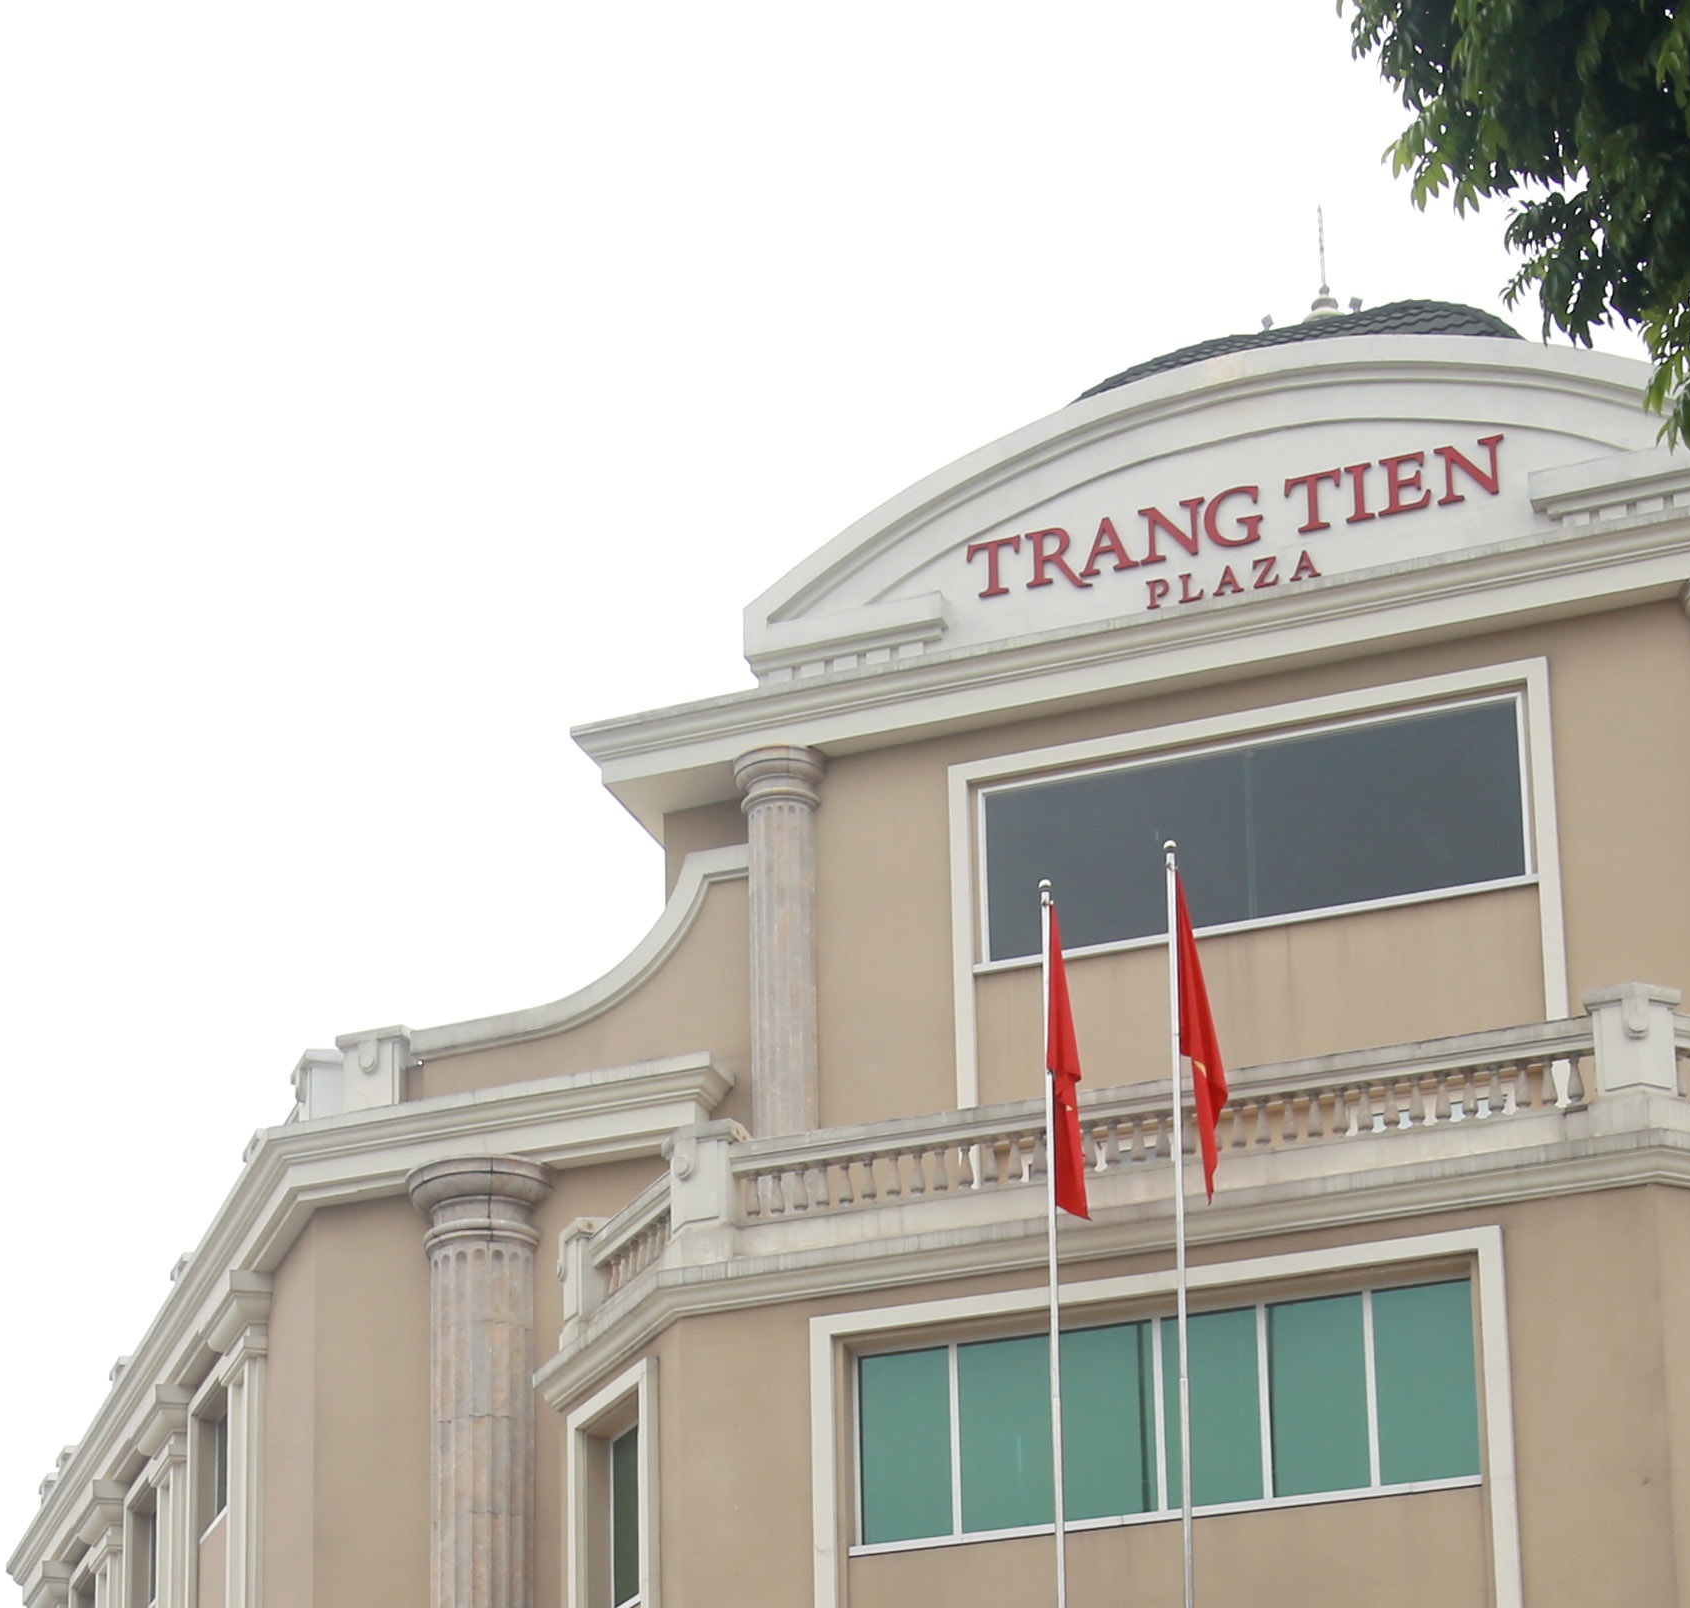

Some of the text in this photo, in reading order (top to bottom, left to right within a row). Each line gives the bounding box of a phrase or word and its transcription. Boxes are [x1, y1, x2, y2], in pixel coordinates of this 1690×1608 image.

[966, 434, 1506, 599] TRANG TIEN
[1146, 550, 1323, 610] PLAZA
